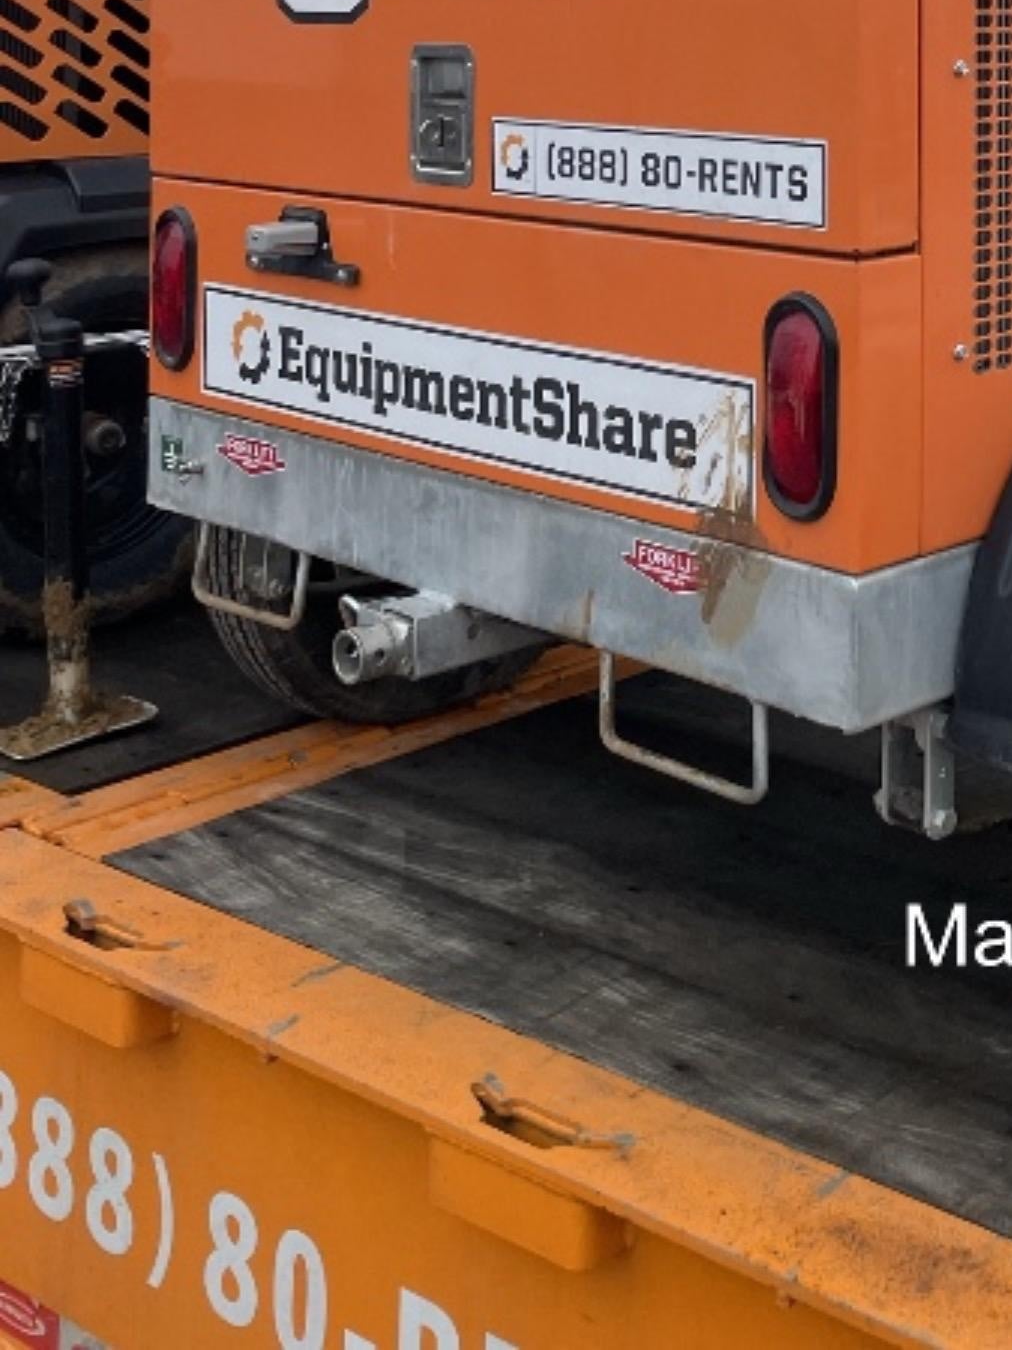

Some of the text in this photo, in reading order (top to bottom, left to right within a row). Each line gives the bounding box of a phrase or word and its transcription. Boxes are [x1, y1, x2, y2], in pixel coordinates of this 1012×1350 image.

[548, 143, 809, 202] (888) 80-RENTS
[278, 326, 698, 470] EquipmentShare
[639, 545, 699, 573] FORKLI
